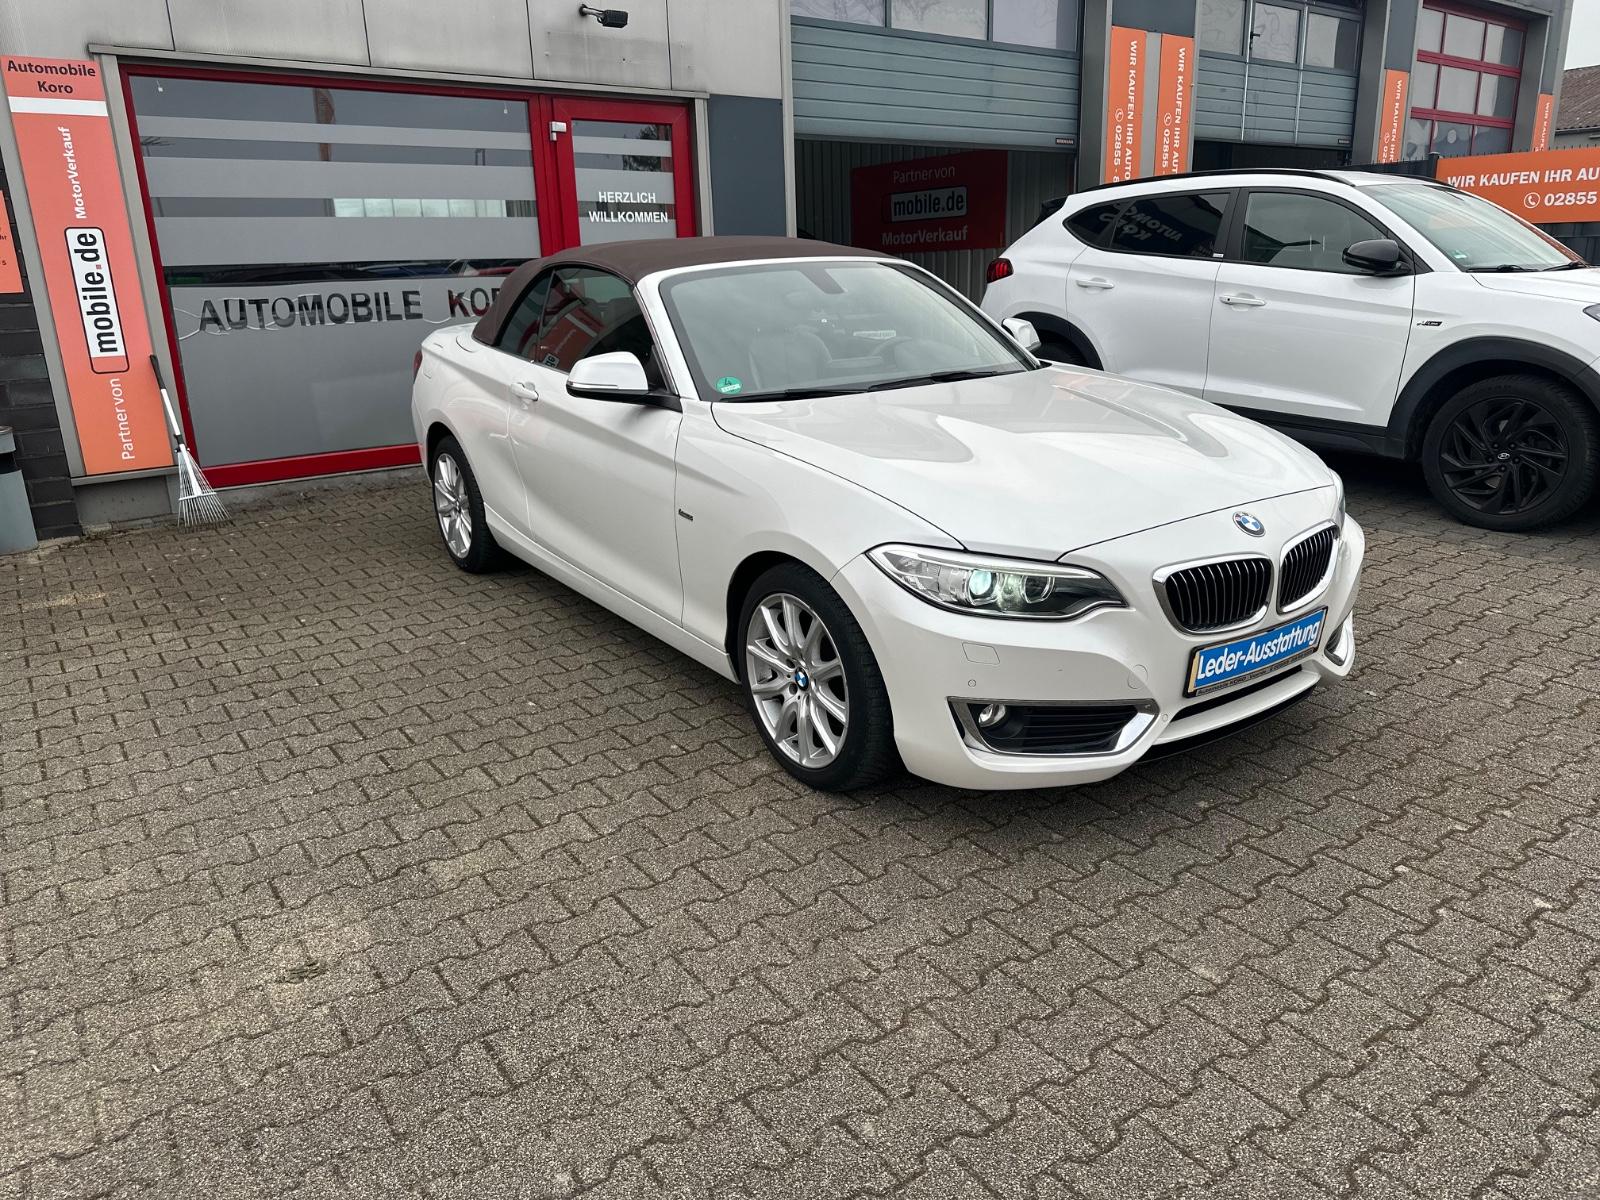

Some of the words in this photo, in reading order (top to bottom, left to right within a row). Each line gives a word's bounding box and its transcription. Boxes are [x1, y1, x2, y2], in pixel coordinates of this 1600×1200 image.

[1129, 41, 1137, 65] WIR
[1177, 48, 1186, 72] WIR
[7, 60, 96, 77] Automobile
[37, 81, 73, 94] Koro
[1127, 70, 1136, 119] KAUFEN
[1175, 76, 1184, 124] KAUFEN
[1126, 124, 1134, 145] IHR
[1391, 102, 1400, 142] KAUFEN
[1113, 125, 1122, 165] 02855
[1162, 128, 1171, 168] 02855
[1173, 128, 1181, 148] IHR
[58, 126, 87, 219] MotorVerkauf
[893, 169, 933, 184] Partner
[935, 166, 956, 179] von
[1447, 175, 1475, 188] WIR
[1479, 171, 1540, 187] KAUFEN
[1544, 169, 1573, 183] IHR
[598, 191, 656, 203] HERZLICH
[893, 191, 964, 217] mobile.de
[1544, 191, 1598, 206] 02855
[588, 210, 669, 223] WILLKOMMEN
[882, 225, 969, 246] MotorVerkauf
[73, 232, 118, 353] mobile.de
[200, 290, 424, 332] AUTOMOBILE
[109, 378, 124, 406] von
[115, 405, 136, 460] Partner
[1197, 620, 1321, 680] Leder-Ausstattung
